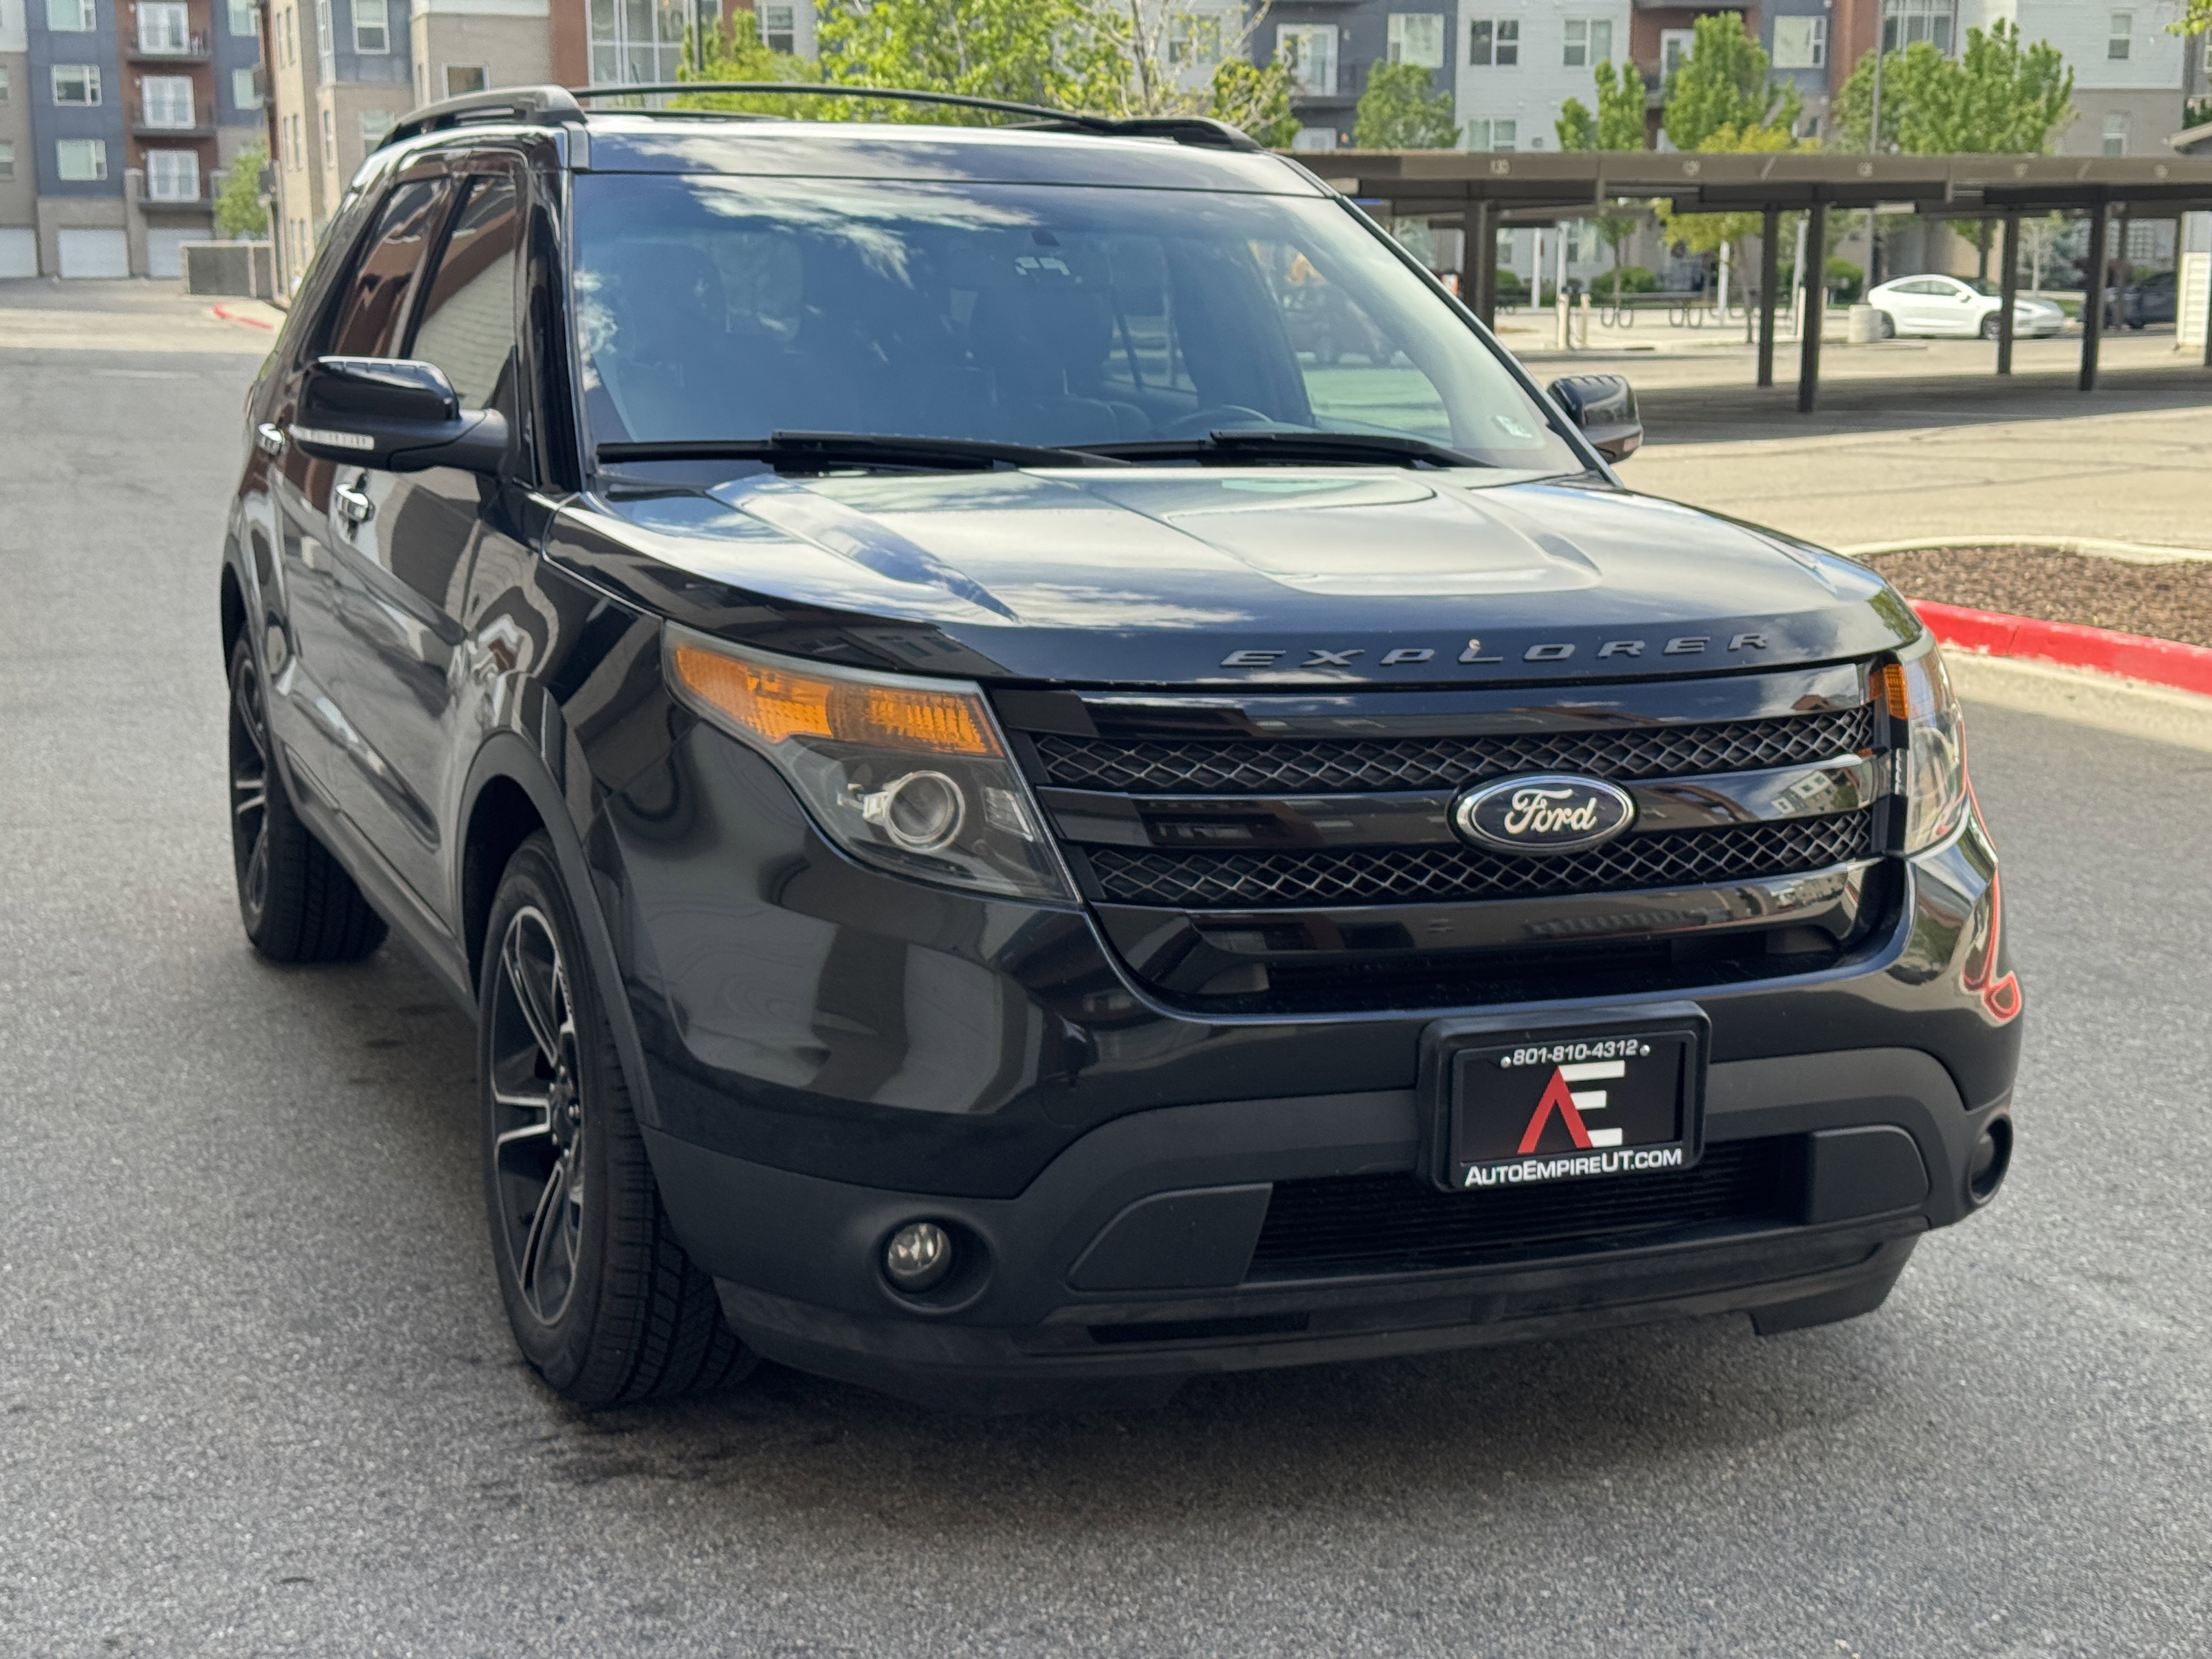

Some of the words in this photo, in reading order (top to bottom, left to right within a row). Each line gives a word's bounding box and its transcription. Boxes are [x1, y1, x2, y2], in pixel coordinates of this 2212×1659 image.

[1220, 632, 1770, 668] EXPLORER
[1505, 789, 1597, 834] Ford
[1513, 1039, 1639, 1066] 801-810-4312
